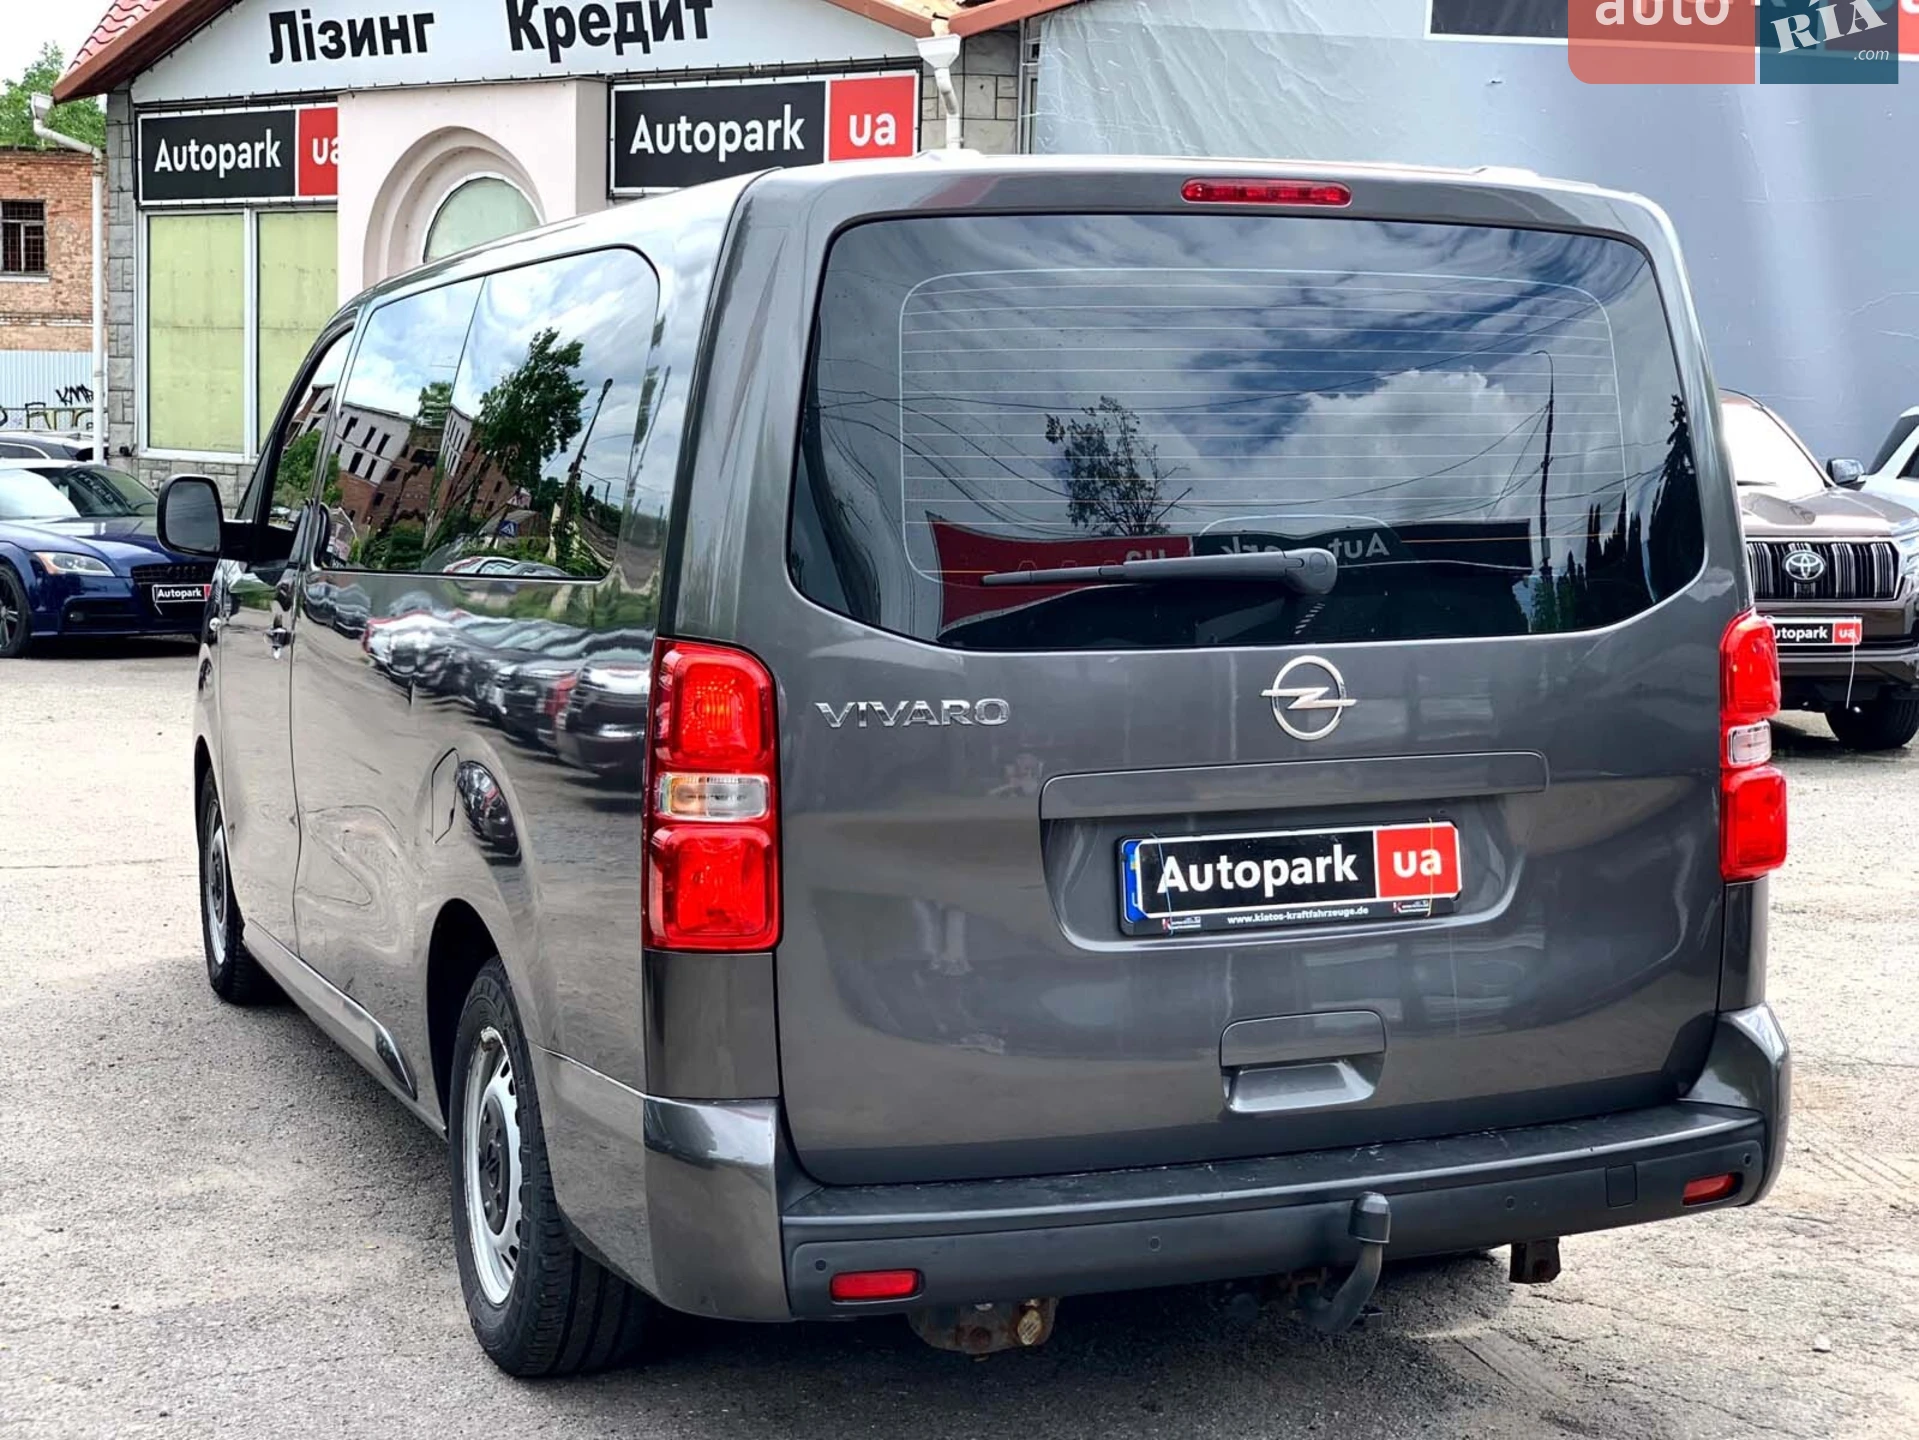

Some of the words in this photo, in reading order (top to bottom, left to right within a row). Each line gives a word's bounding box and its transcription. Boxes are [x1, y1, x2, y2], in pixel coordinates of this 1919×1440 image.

[269, 8, 434, 64] Лізинг
[505, 0, 713, 64] Кредит
[154, 128, 281, 179] Autopark
[629, 103, 805, 163] Autopark
[849, 111, 896, 147] ua
[157, 588, 202, 599] Autopark
[1775, 625, 1828, 642] utopark
[1839, 628, 1855, 639] ua
[814, 698, 1010, 728] VIVARO
[1157, 843, 1359, 898] Autopark
[1392, 848, 1442, 878] ua
